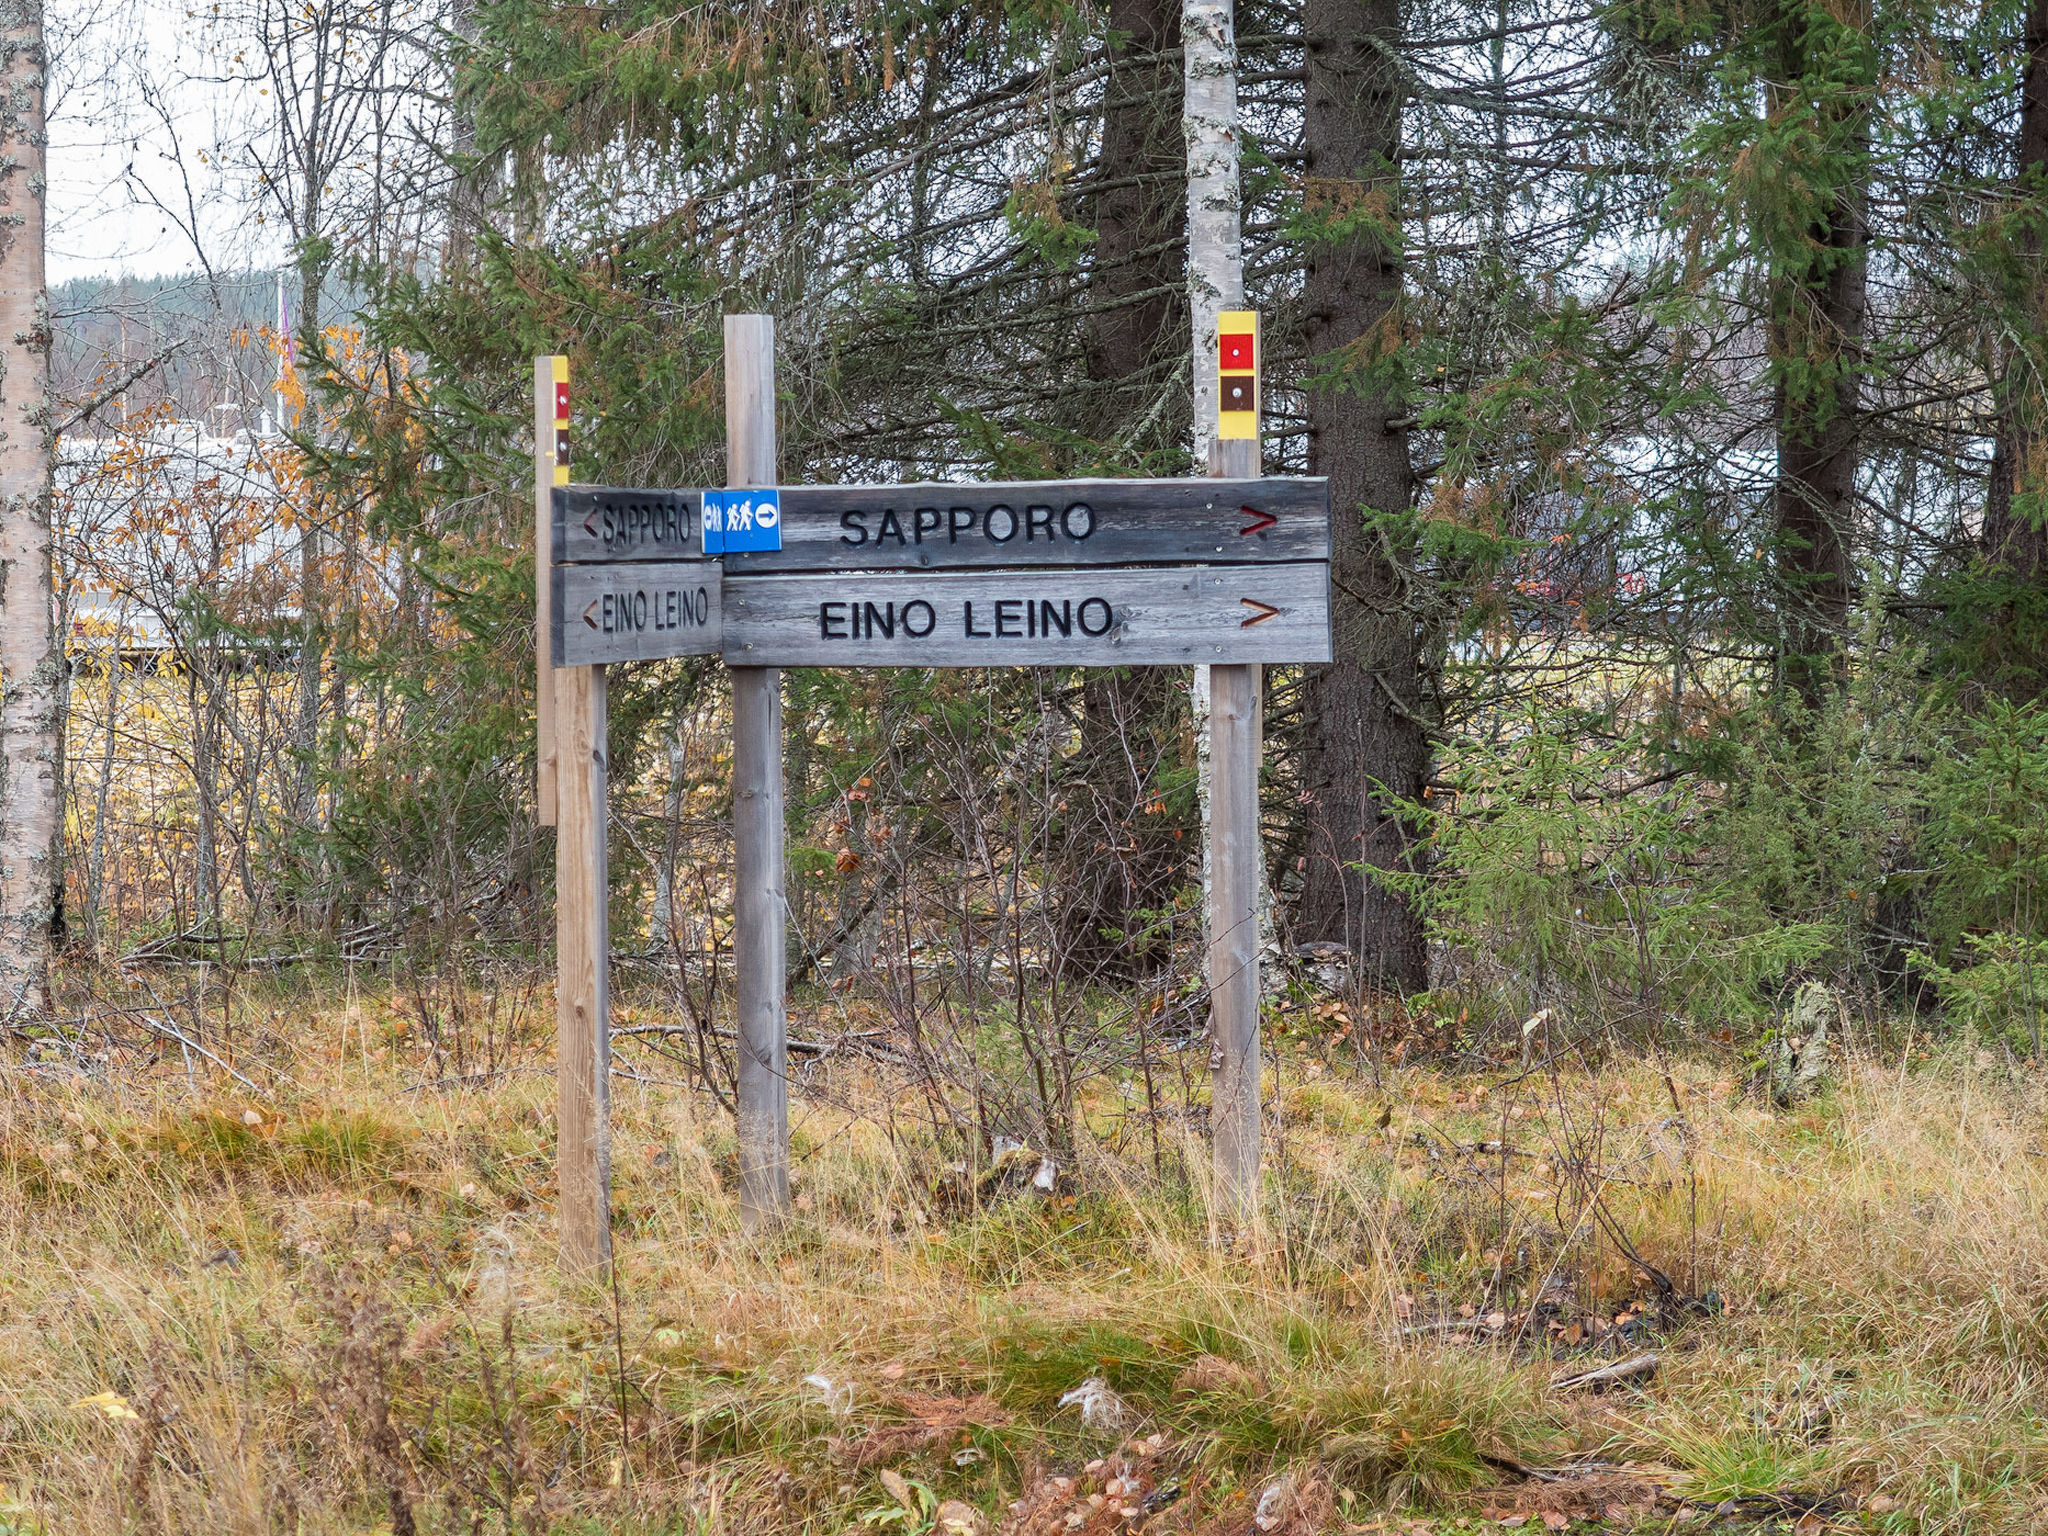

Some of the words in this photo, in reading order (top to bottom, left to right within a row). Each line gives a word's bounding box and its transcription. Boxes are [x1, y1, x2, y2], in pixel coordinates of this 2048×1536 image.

[603, 502, 691, 545] SAPPORO
[839, 502, 1097, 548] SAPPORO
[602, 590, 647, 634] EINO
[655, 586, 709, 631] LEINO
[820, 600, 936, 641] EINO
[964, 597, 1113, 639] LEINO
